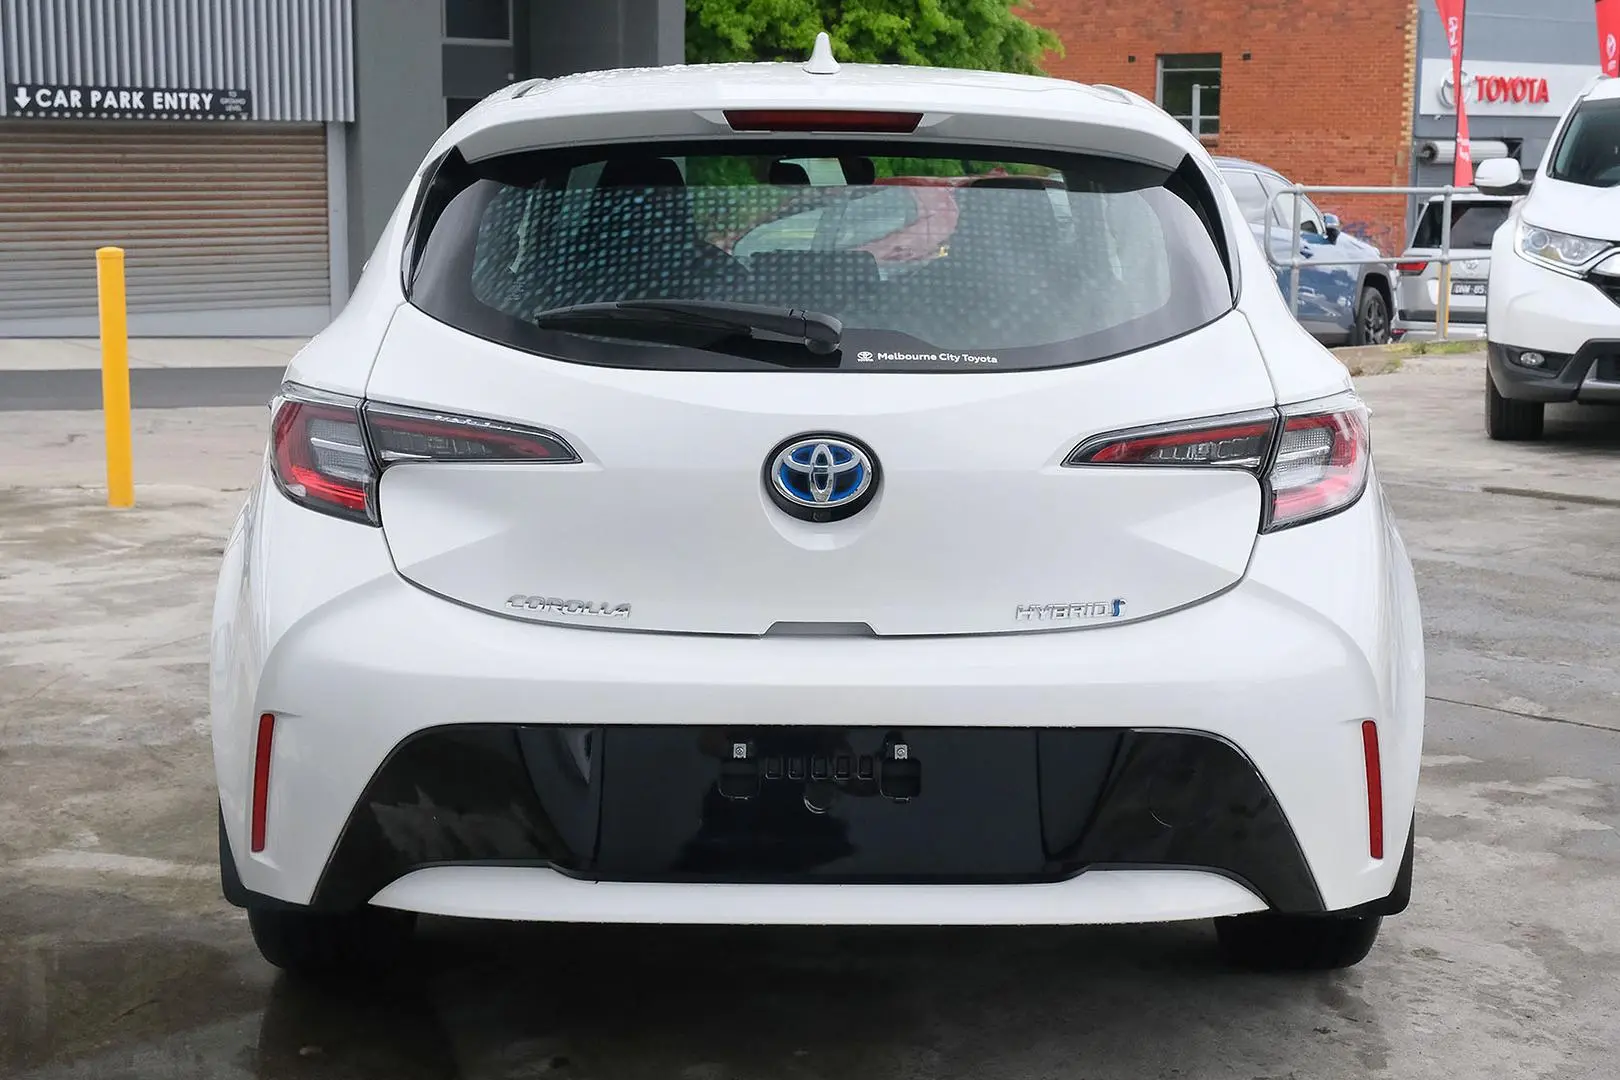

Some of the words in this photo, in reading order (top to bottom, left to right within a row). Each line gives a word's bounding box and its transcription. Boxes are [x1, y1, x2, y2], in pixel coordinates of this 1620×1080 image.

[35, 88, 82, 108] CAR
[90, 90, 145, 109] PARK
[152, 91, 213, 110] ENTRY
[1475, 75, 1549, 104] TOYOTA
[877, 352, 937, 361] Melbourne
[938, 353, 961, 363] City
[961, 353, 998, 364] Toyota
[505, 594, 631, 618] COROLLA
[1015, 602, 1109, 620] HYBRID
